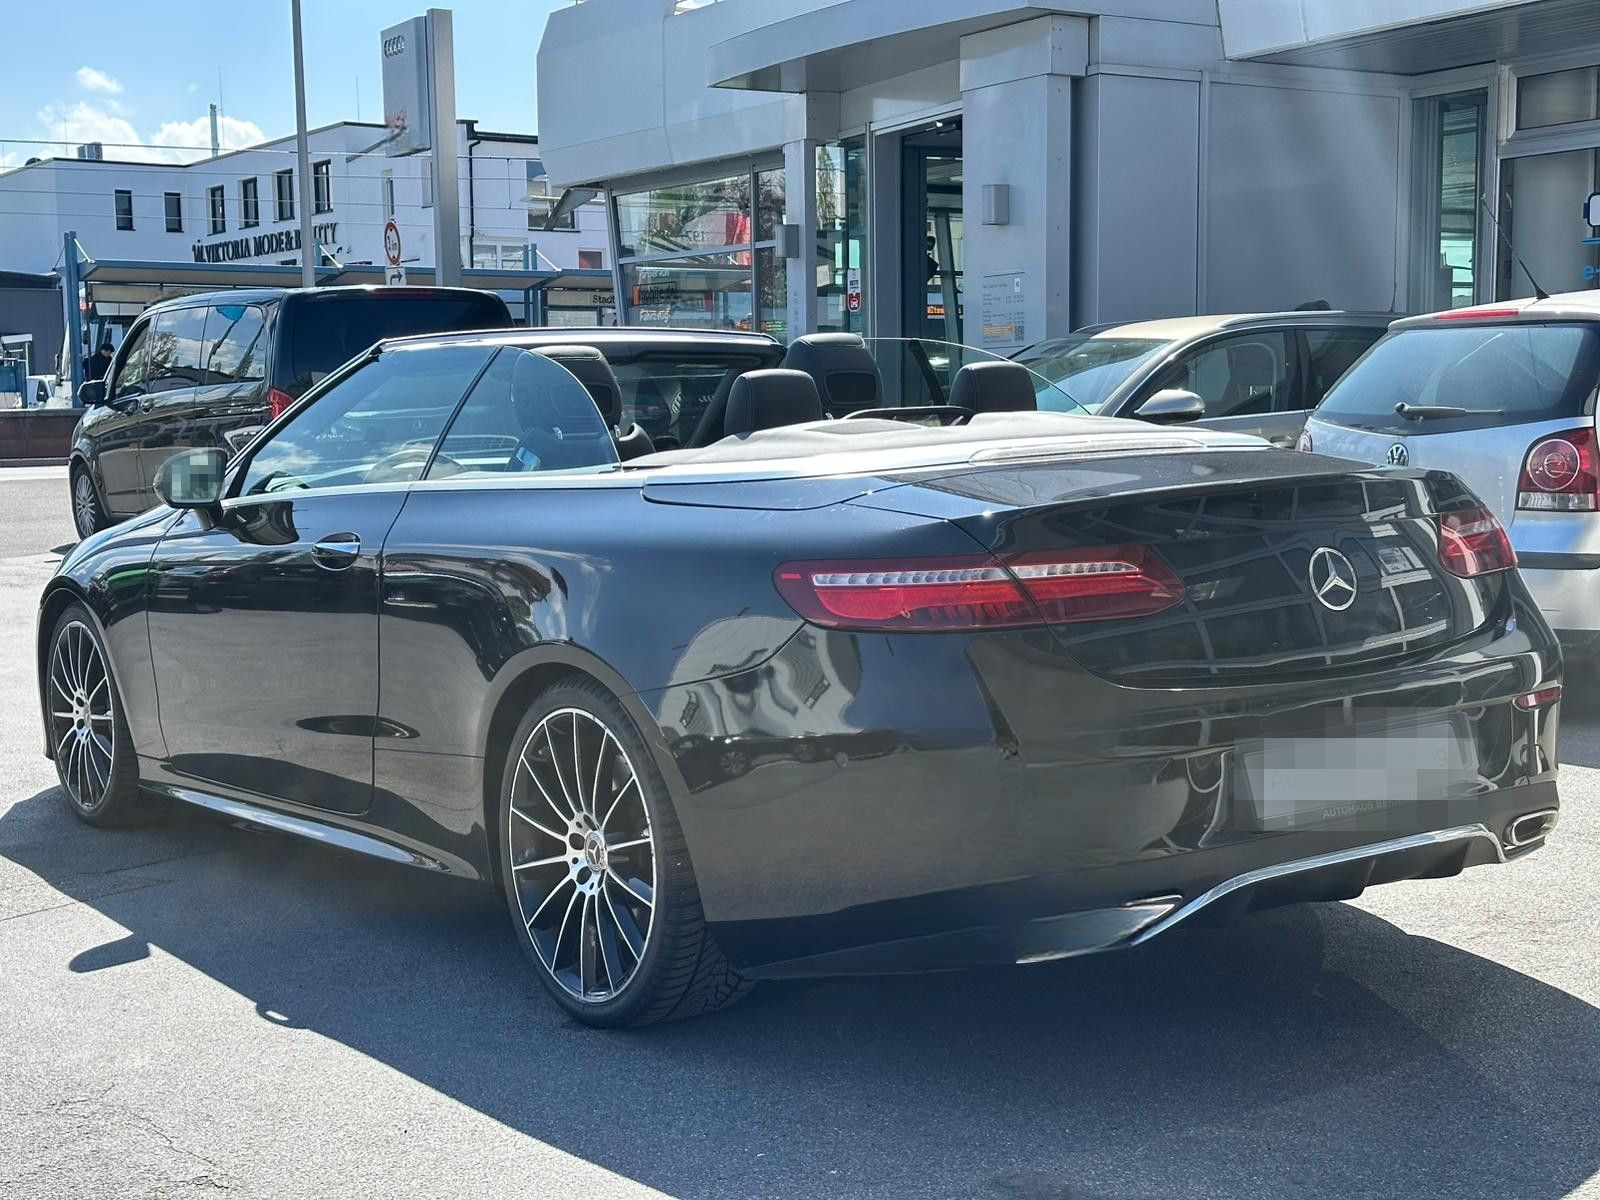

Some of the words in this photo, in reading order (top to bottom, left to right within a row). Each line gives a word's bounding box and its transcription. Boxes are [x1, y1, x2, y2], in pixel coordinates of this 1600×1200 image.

[205, 237, 251, 263] VIKTORIA
[592, 294, 615, 304] Stadt
[1322, 801, 1374, 819] AUTOHAUS
[1376, 792, 1417, 808] BERNING
